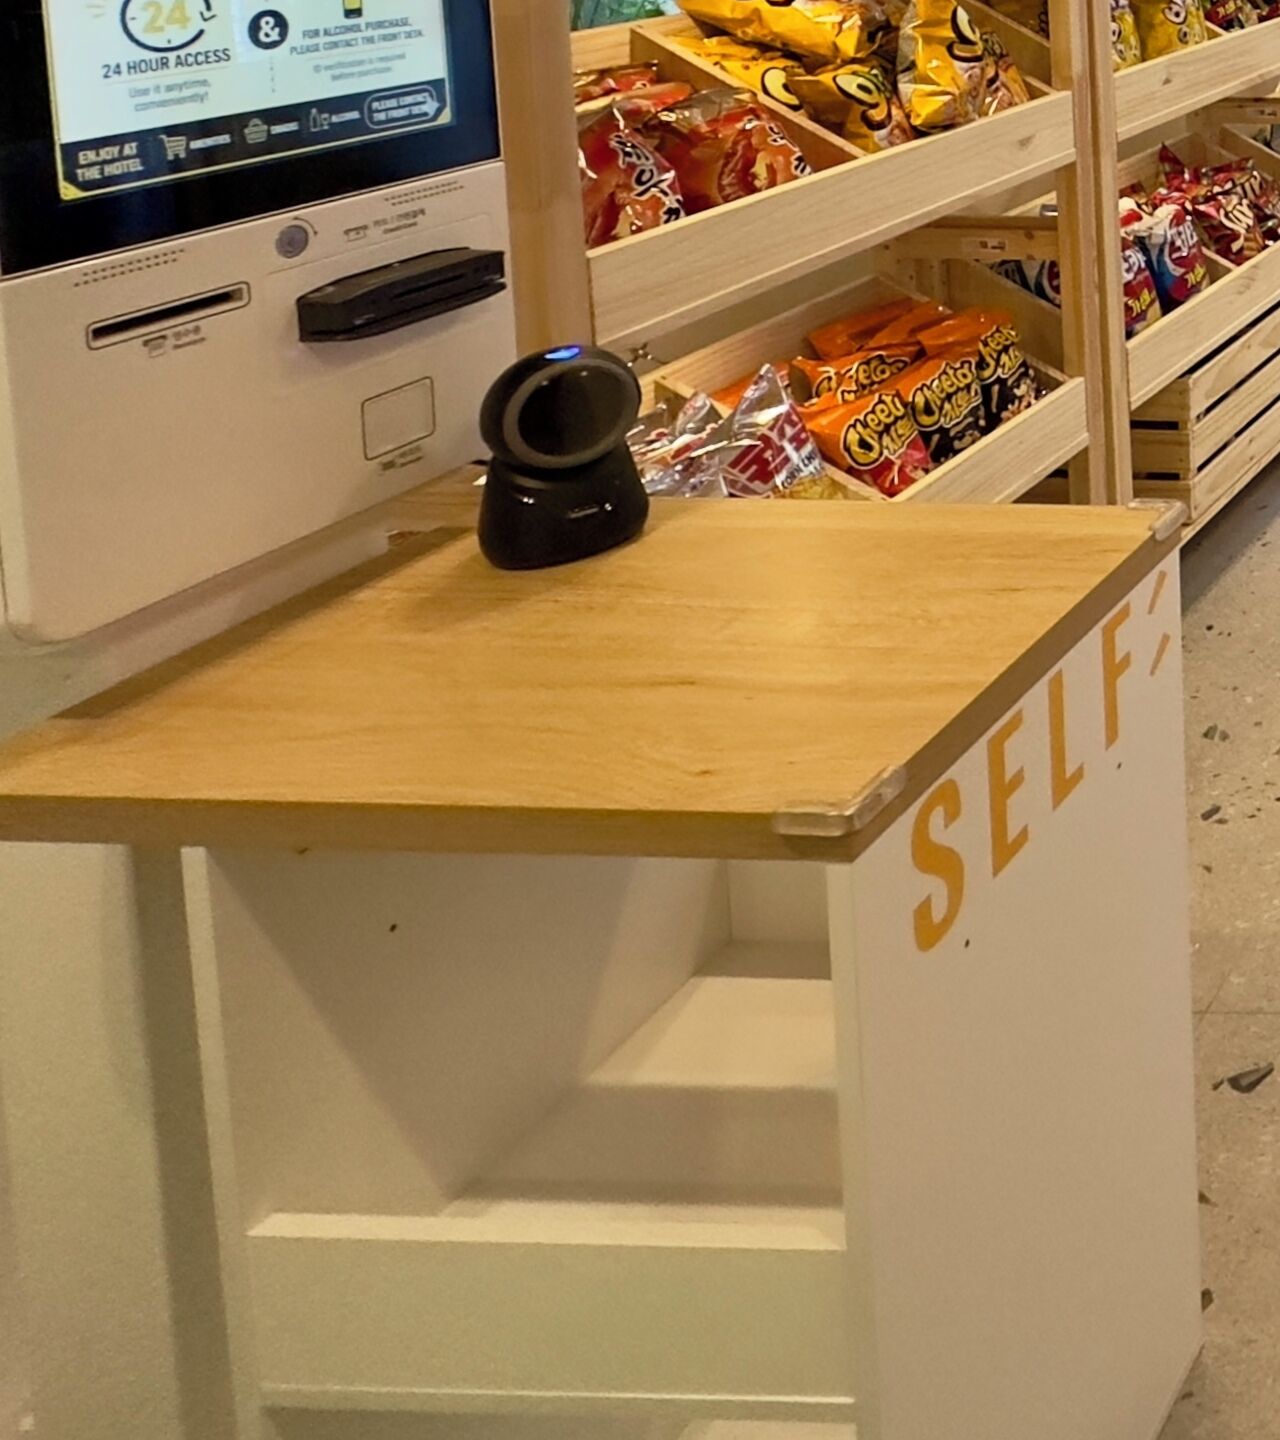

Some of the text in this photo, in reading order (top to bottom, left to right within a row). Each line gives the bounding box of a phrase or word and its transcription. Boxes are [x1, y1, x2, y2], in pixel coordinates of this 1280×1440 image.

[290, 43, 321, 56] PLEASE
[323, 37, 359, 52] CONTACT
[361, 34, 376, 46] THE
[377, 32, 401, 44] FRONT
[302, 28, 321, 40] FOR
[323, 24, 363, 38] ALCOHOL
[102, 48, 232, 80] 24 HOUR ACCESS
[129, 86, 151, 99] Use
[153, 84, 162, 94] it
[78, 142, 139, 165] ENJOY AT
[76, 157, 145, 183] THE HOTEL
[910, 600, 1132, 954] SELF
